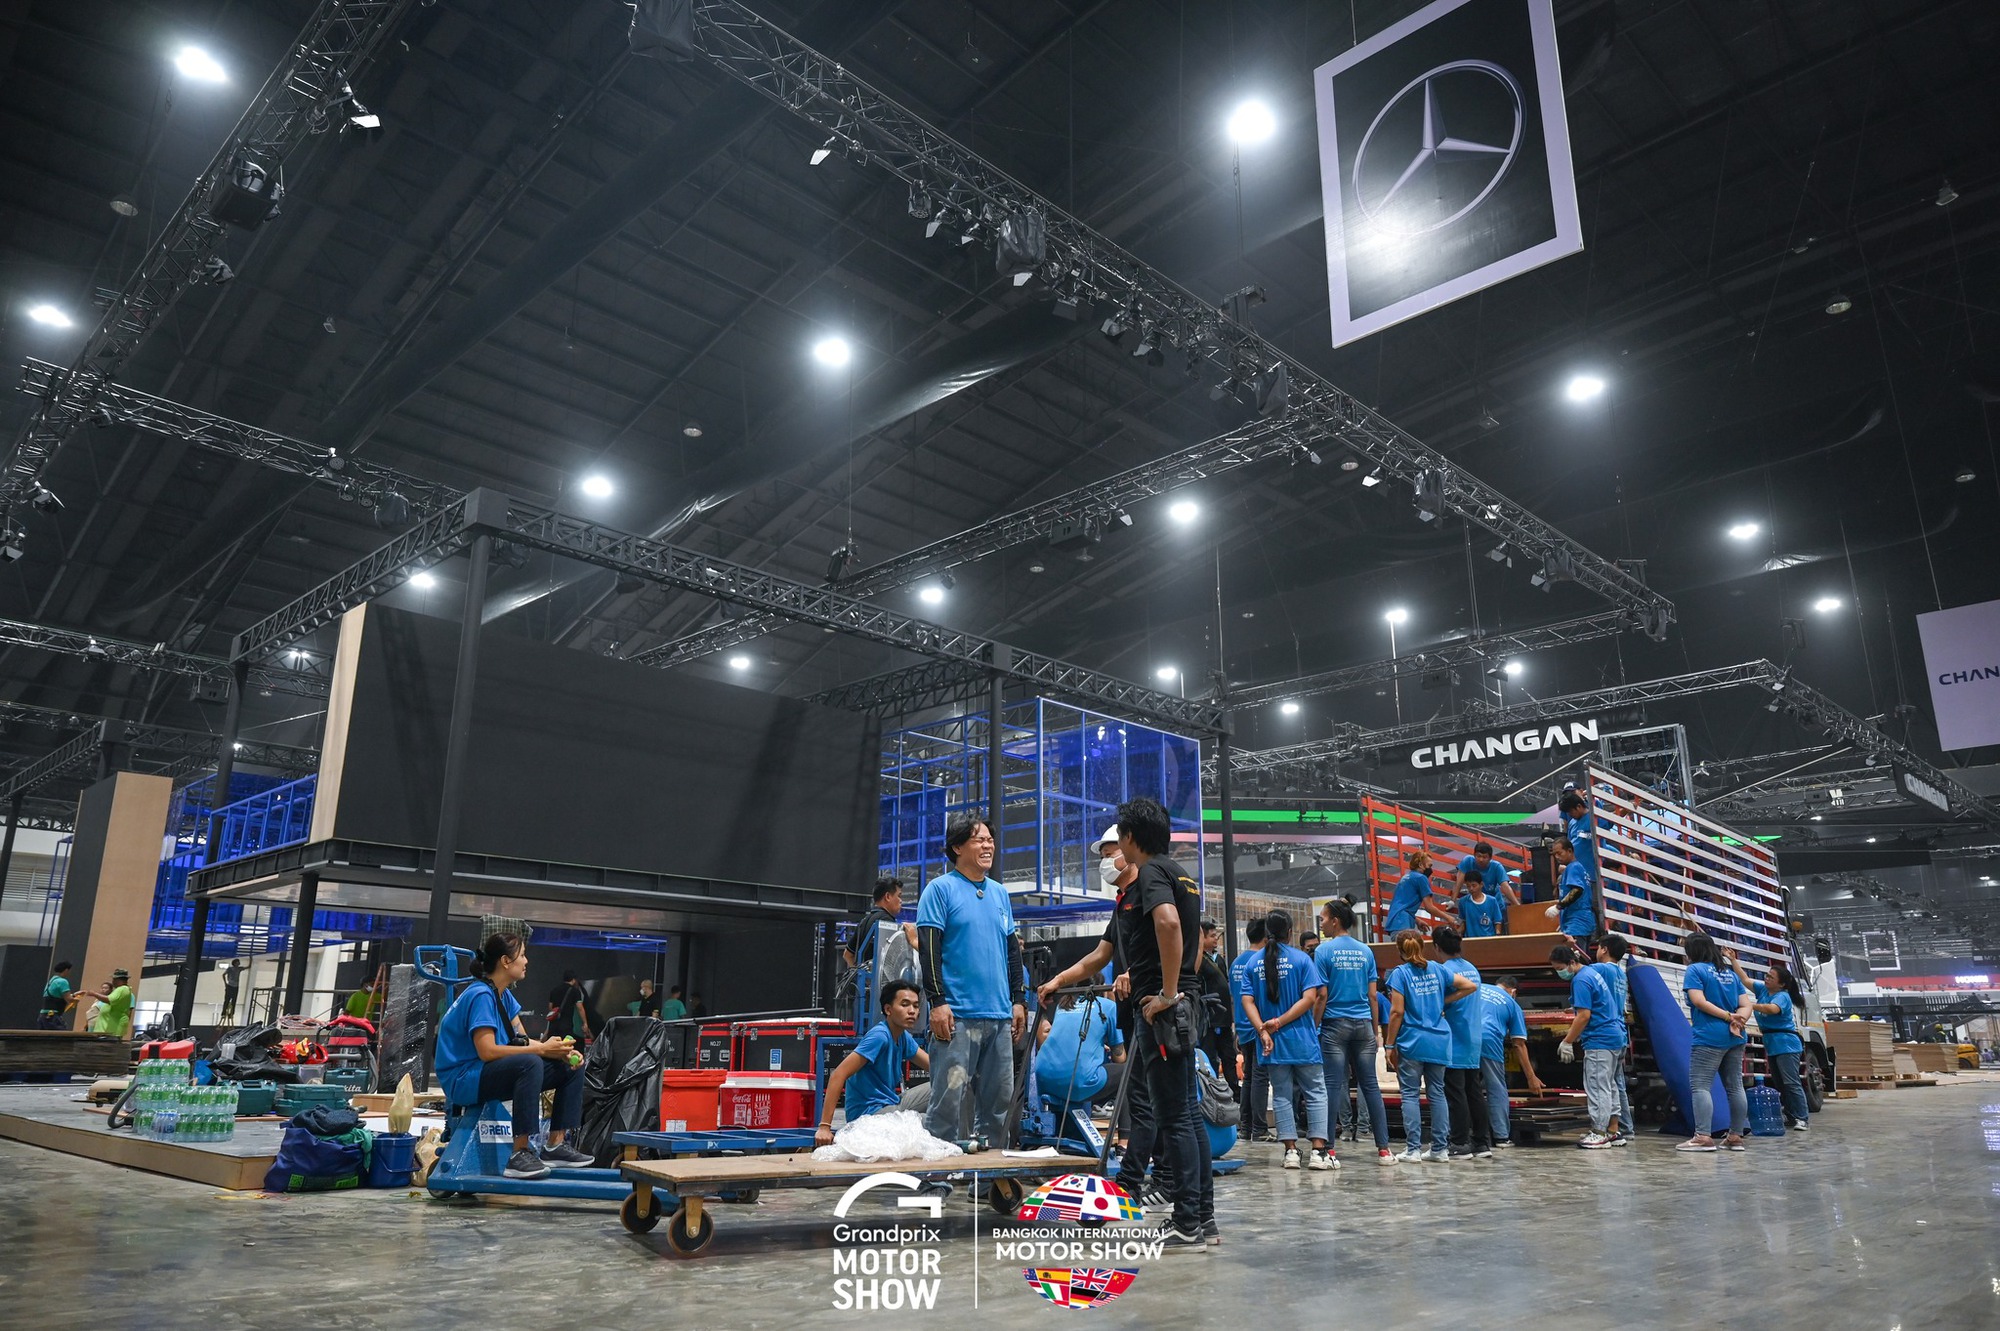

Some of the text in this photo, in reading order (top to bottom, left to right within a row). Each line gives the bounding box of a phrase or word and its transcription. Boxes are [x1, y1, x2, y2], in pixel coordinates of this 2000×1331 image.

[1939, 666, 2000, 685] CHAN
[1411, 719, 1599, 769] CHANGAN
[344, 1084, 361, 1092] kita
